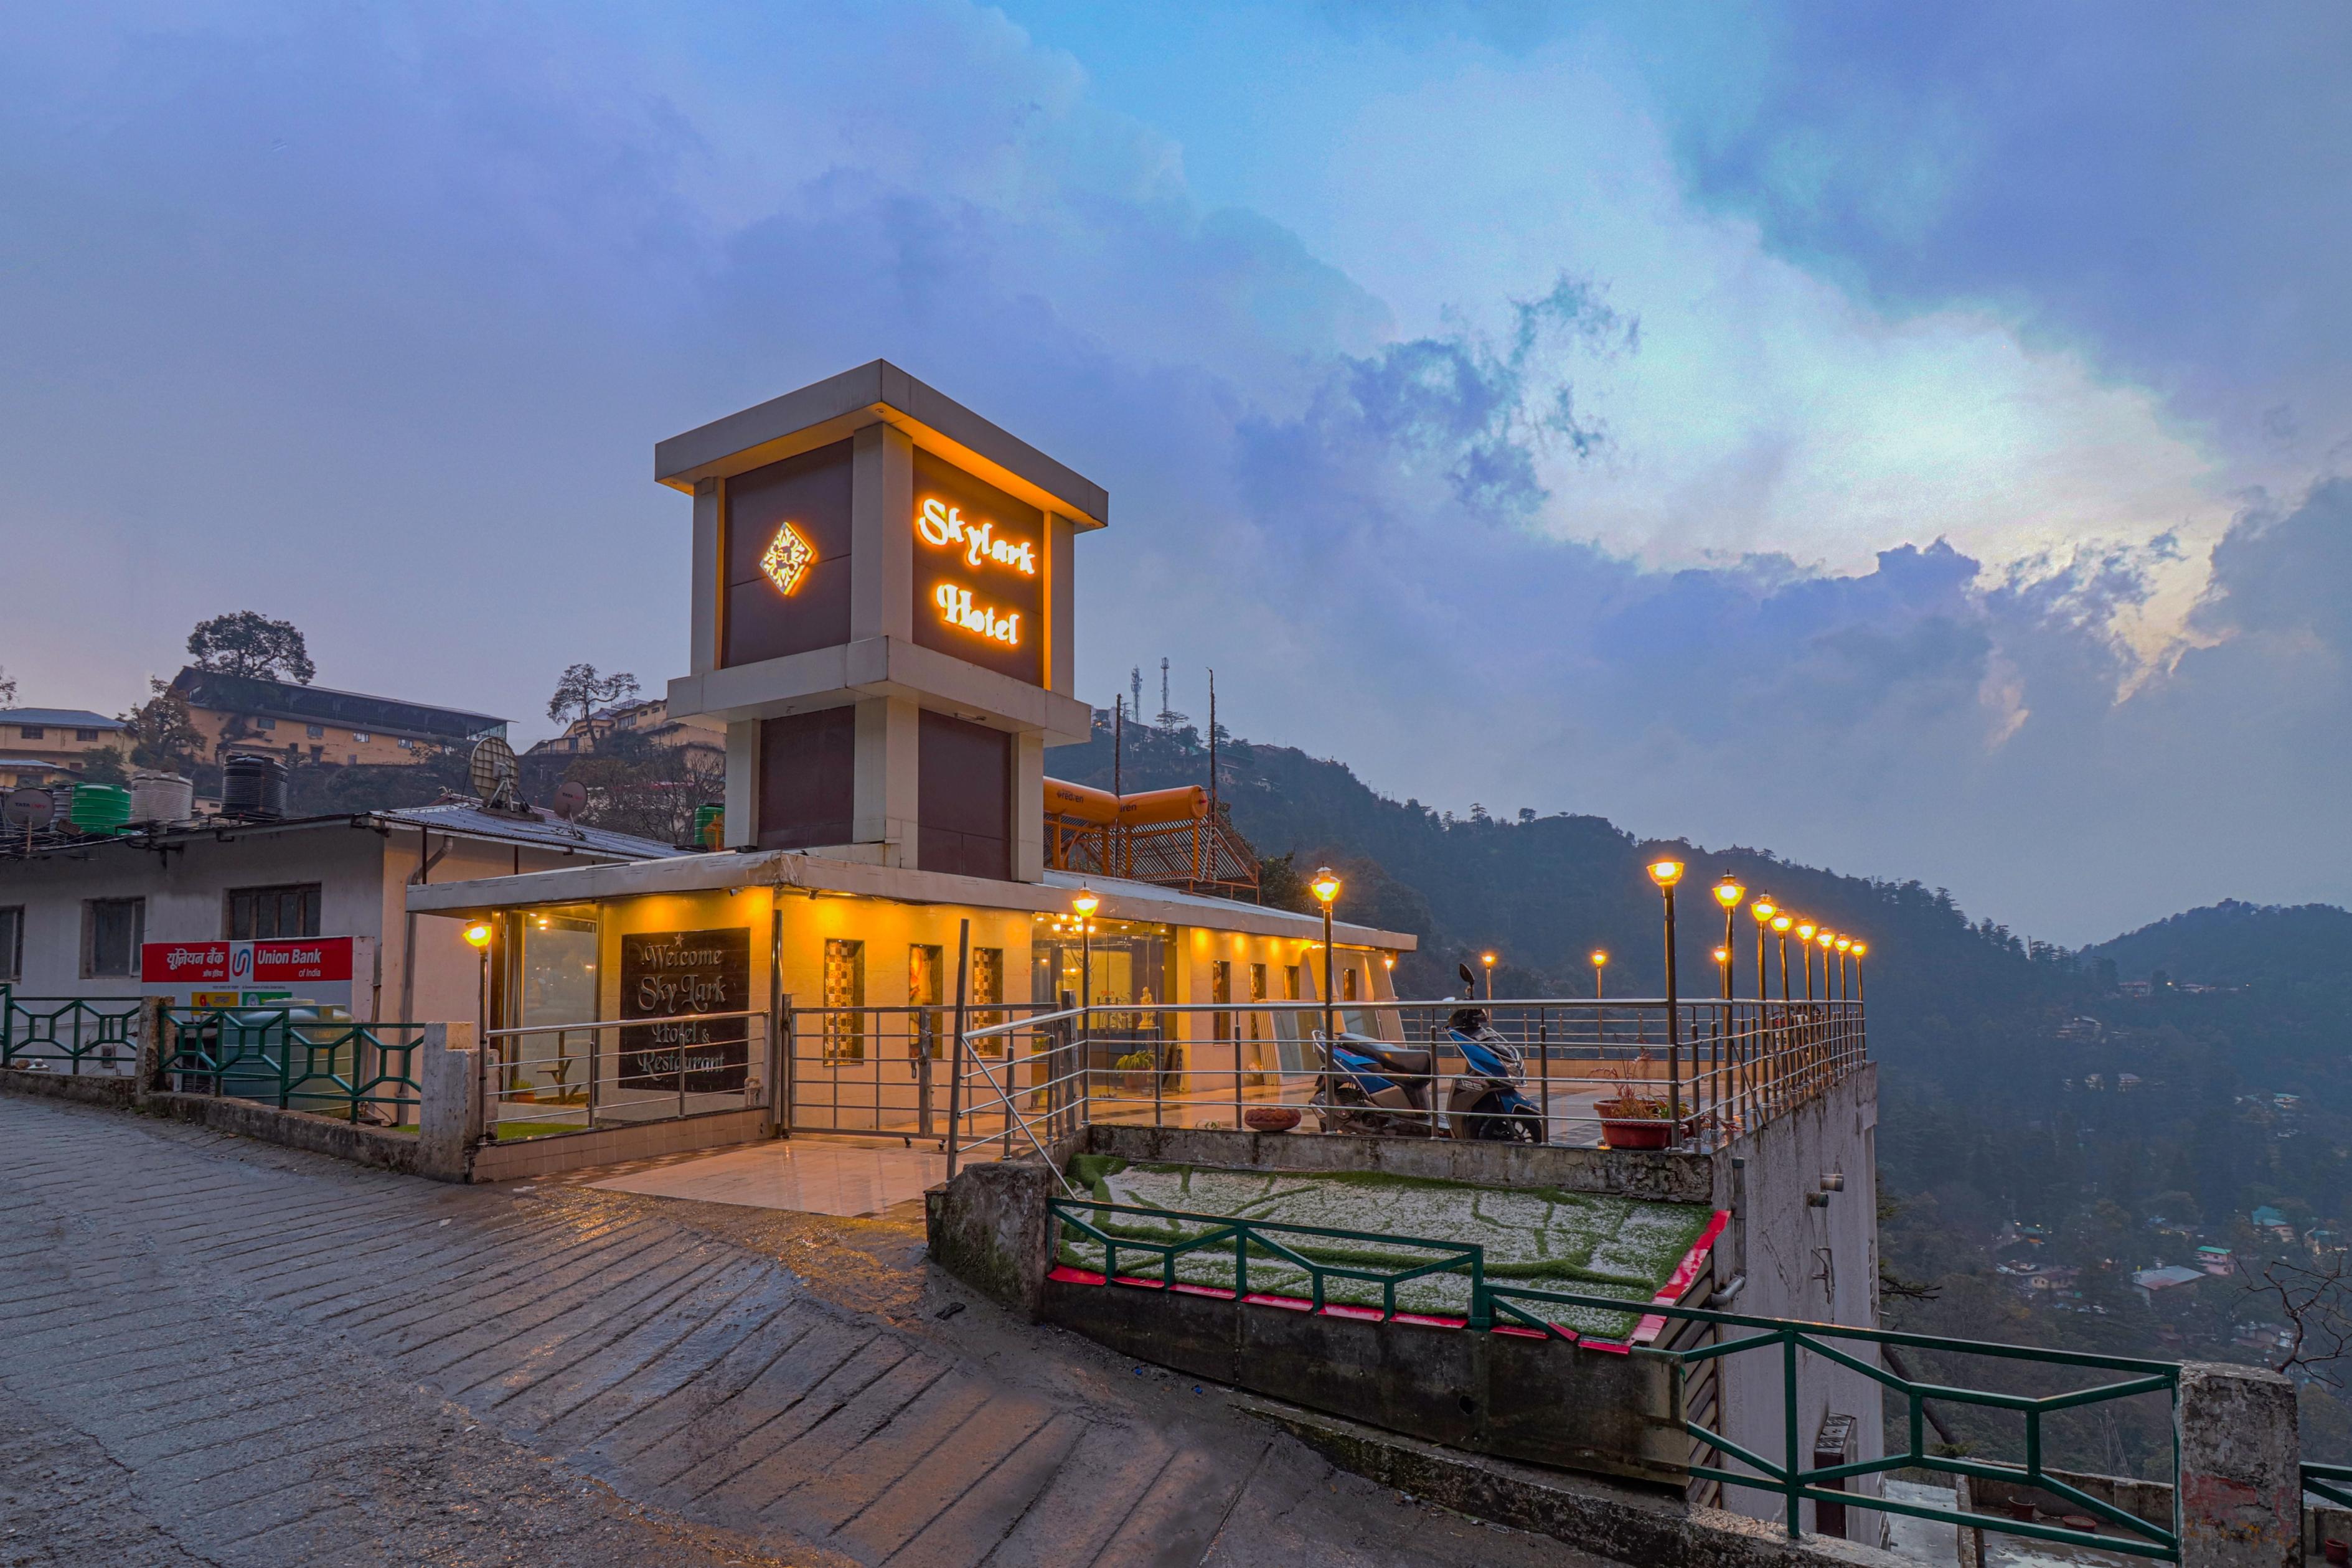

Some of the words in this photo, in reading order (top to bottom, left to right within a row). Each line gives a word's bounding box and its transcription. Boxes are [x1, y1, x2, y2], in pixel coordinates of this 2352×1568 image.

[918, 498, 1035, 575] Skylark
[936, 583, 1020, 645] Hotel
[257, 949, 289, 965] Union
[291, 948, 322, 964] Bank
[644, 944, 723, 970] Welcome
[298, 968, 306, 977] of
[306, 968, 321, 977] India
[637, 975, 677, 1014] Sky
[680, 974, 727, 1013] Lark
[651, 1021, 698, 1044] Hotel
[702, 1028, 711, 1043] &
[637, 1051, 725, 1082] Restaurant
[1461, 1079, 1484, 1091] 125
